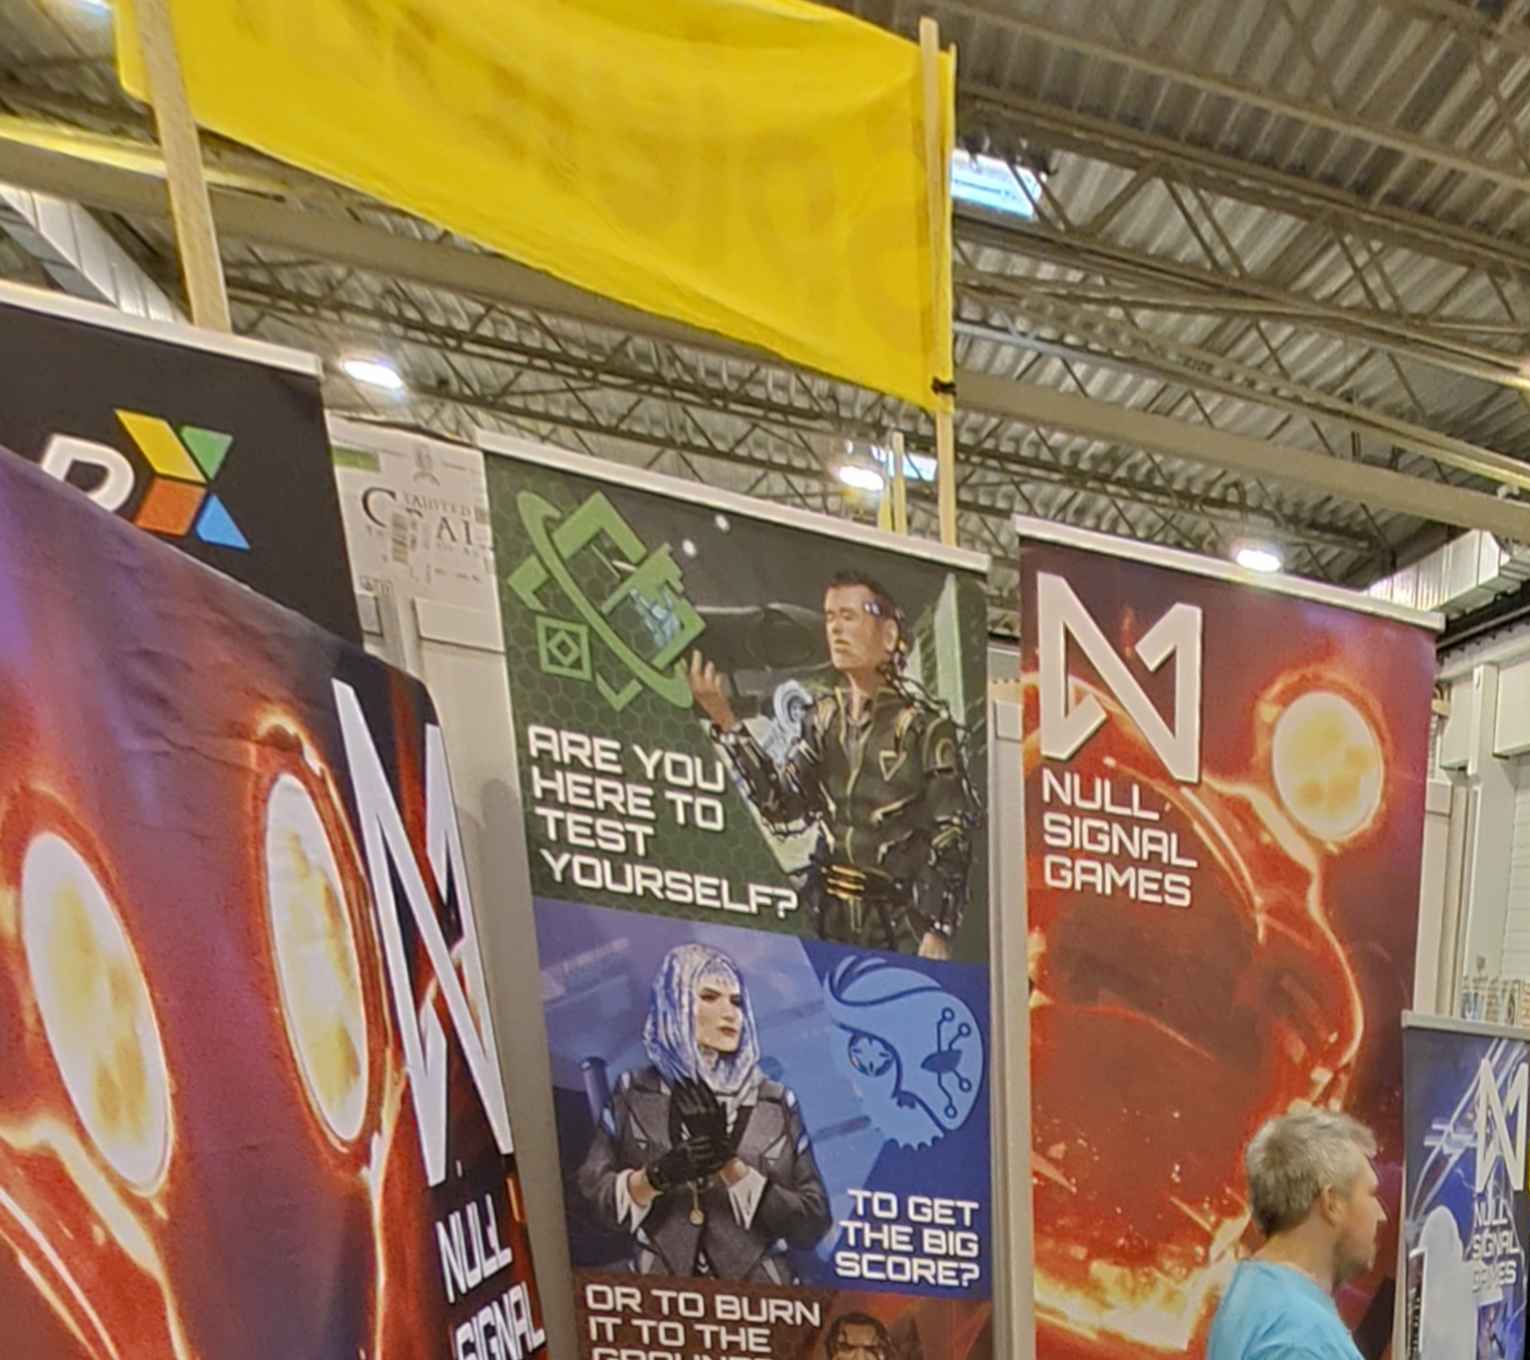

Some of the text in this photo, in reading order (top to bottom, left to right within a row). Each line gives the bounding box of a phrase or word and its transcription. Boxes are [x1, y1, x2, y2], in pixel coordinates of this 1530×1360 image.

[528, 724, 726, 794] ARE YOU
[530, 765, 725, 833] HERE TO
[1042, 768, 1160, 821] NULL
[534, 806, 654, 858] TEST
[1042, 813, 1199, 868] SIGNAL
[540, 849, 799, 920] YOURSELF?
[1044, 856, 1191, 908] GAMES
[847, 1188, 979, 1228] TO GET
[435, 1193, 512, 1305] NULL
[840, 1220, 979, 1259] THE BIG
[835, 1251, 981, 1288] SCORE?
[584, 1284, 821, 1328] OR TO BURN
[588, 1315, 772, 1354] IT TO THE
